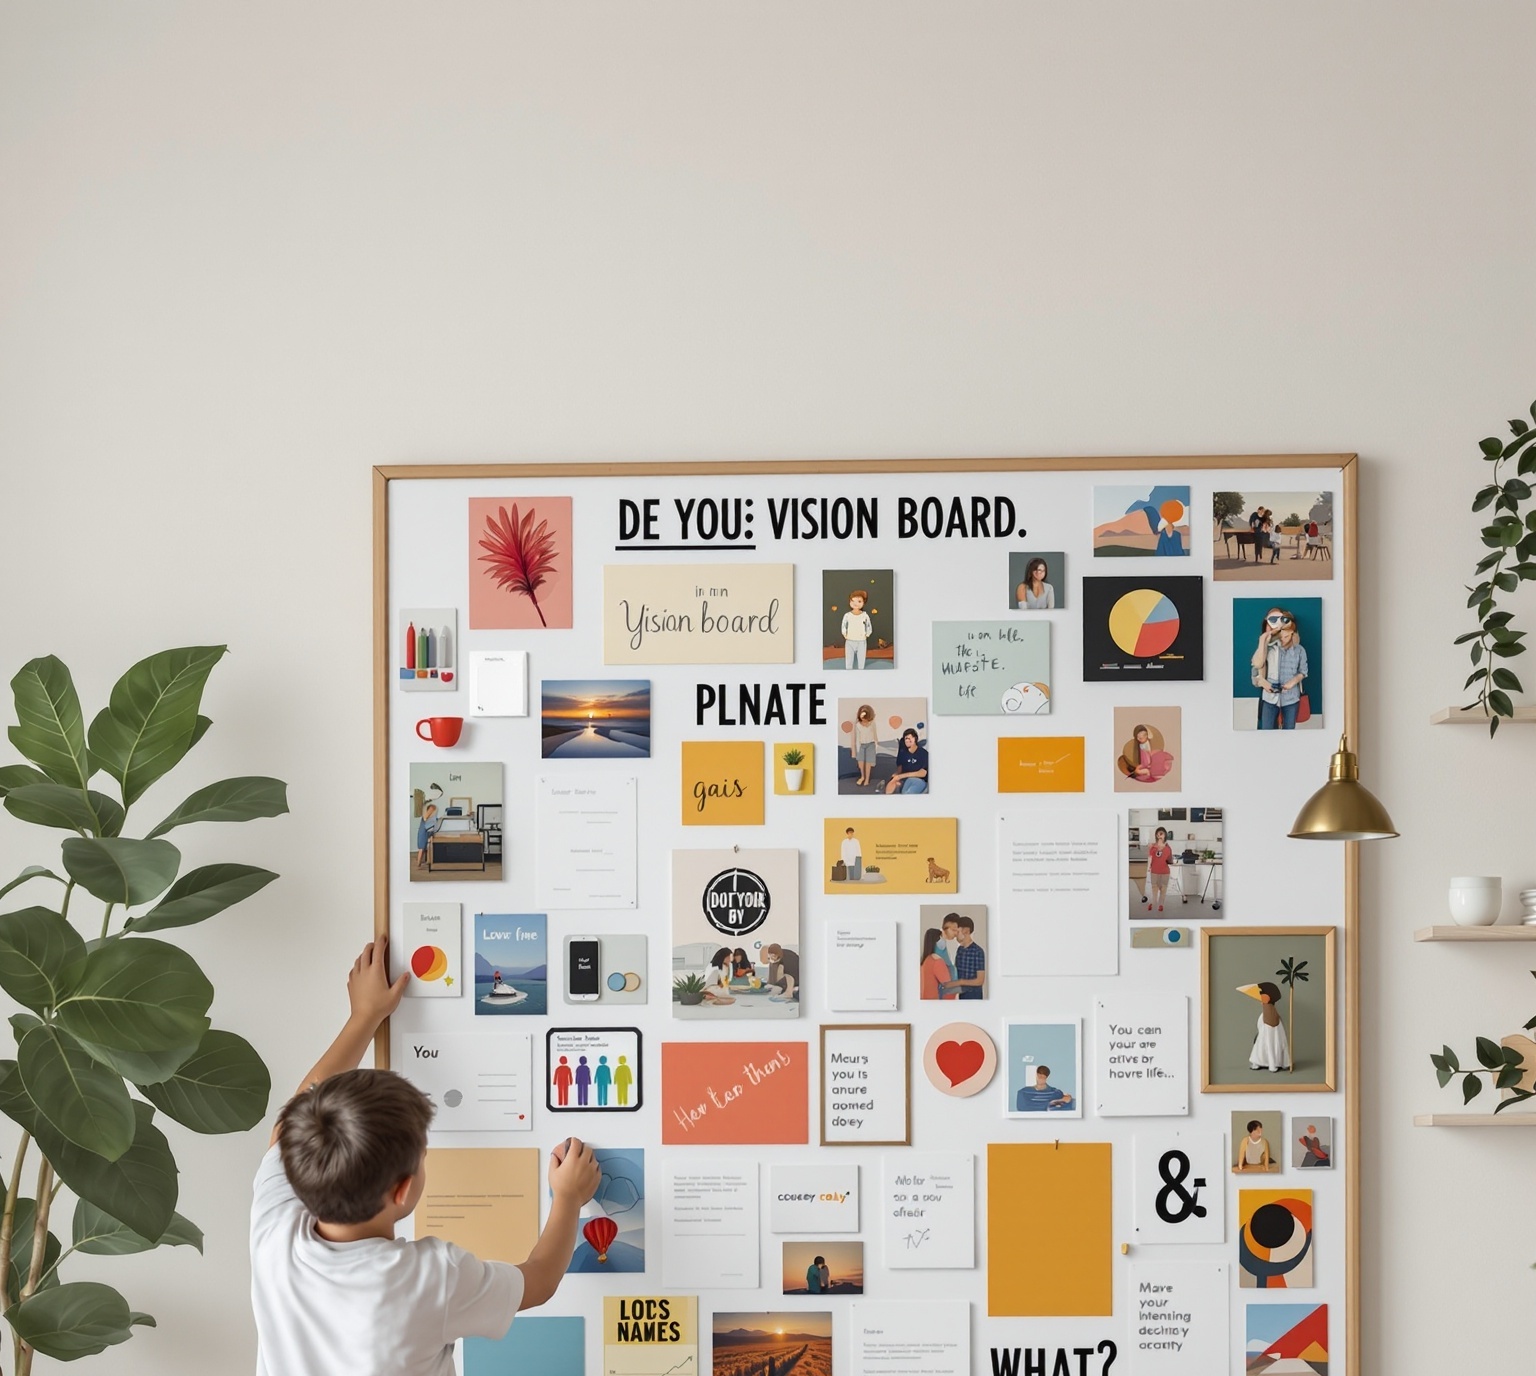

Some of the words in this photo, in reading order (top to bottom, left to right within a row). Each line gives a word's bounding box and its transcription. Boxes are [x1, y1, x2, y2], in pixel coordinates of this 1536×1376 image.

[619, 498, 660, 540] DE
[767, 497, 878, 539] VISION
[898, 495, 1027, 538] BOARD.
[701, 598, 780, 635] board
[696, 683, 827, 726] PLNATE
[1109, 1024, 1133, 1035] You
[413, 1045, 439, 1058] You
[832, 1070, 855, 1081] you
[617, 1321, 681, 1342] NAMES
